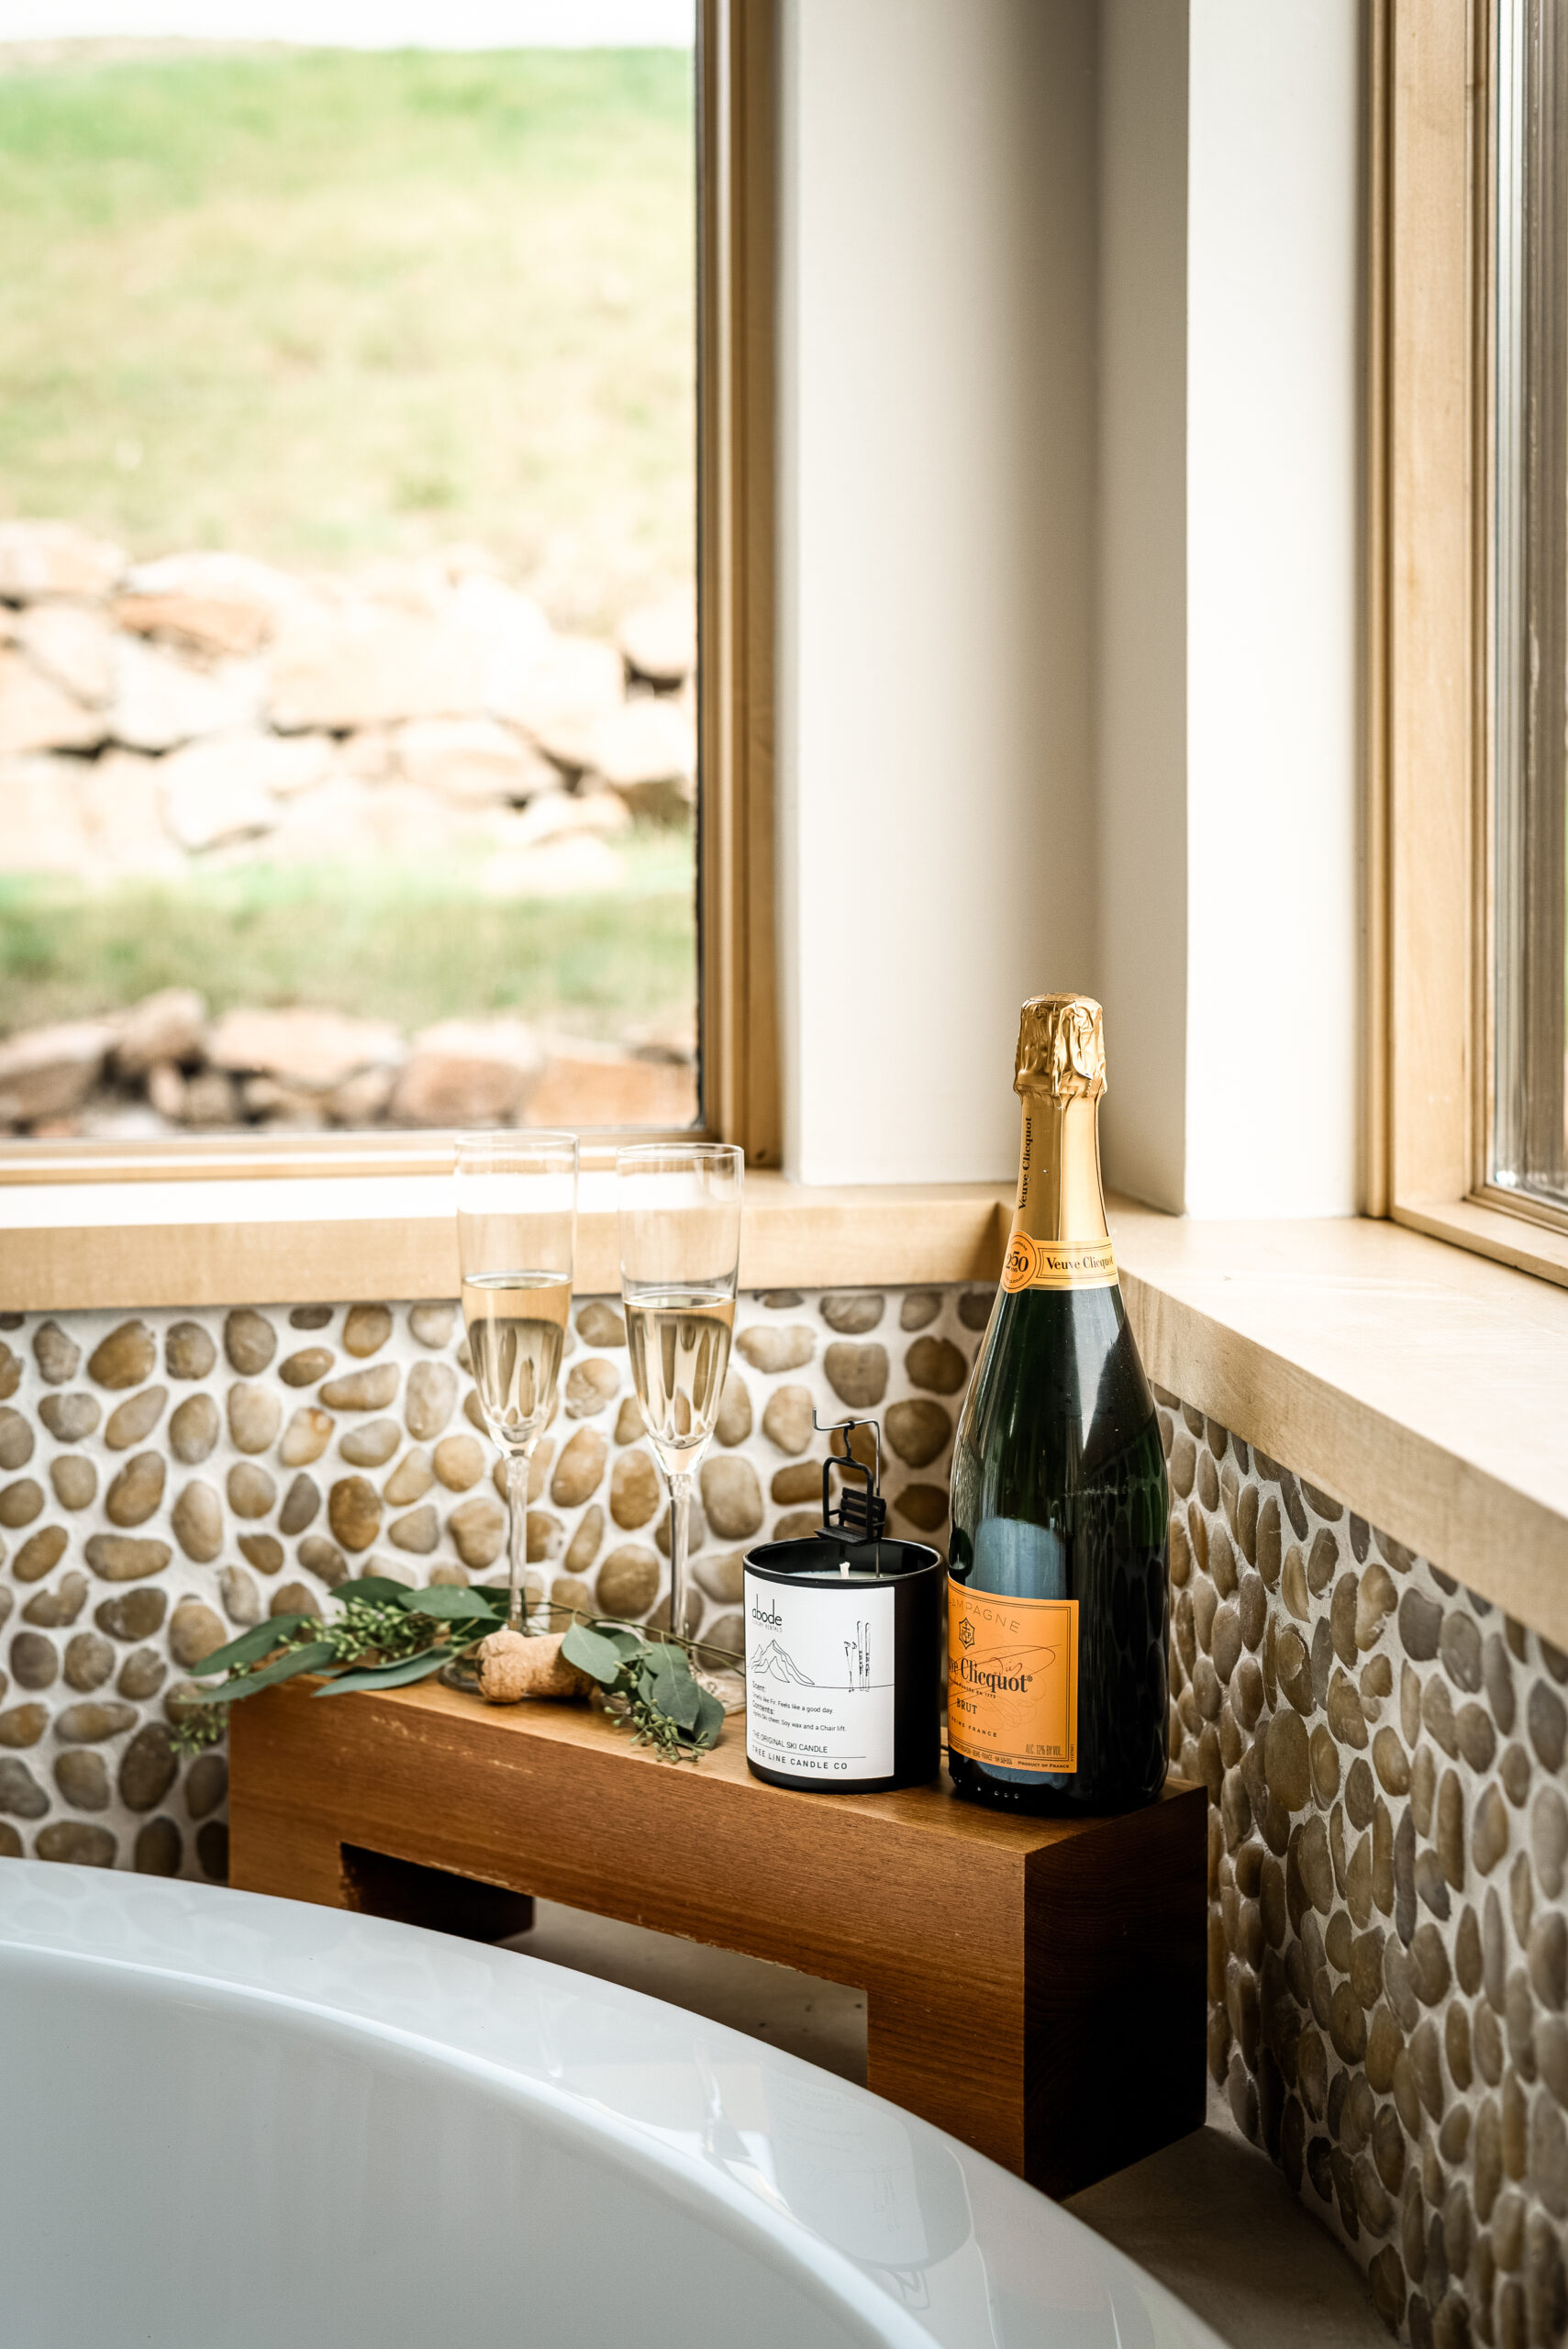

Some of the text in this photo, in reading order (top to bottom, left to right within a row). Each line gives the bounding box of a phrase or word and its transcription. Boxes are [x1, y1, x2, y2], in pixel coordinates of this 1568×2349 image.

[1018, 1116, 1033, 1210] Veuve Clicquot
[1006, 1251, 1029, 1273] 250
[1046, 1254, 1114, 1270] Veuve Clicquot
[751, 1593, 783, 1626] abode
[778, 1700, 790, 1709] Feels
[792, 1703, 800, 1711] like
[806, 1707, 821, 1715] good
[822, 1707, 834, 1715] day.
[956, 1698, 977, 1715] BRUT
[782, 1719, 791, 1728] Soy
[803, 1722, 814, 1731] and
[968, 1725, 997, 1738] FRANCE
[761, 1734, 785, 1748] ORIGINAL
[786, 1741, 797, 1750] SKI
[798, 1743, 828, 1753] CANDLE
[752, 1744, 848, 1770] TREE LINE CANDLE CO
